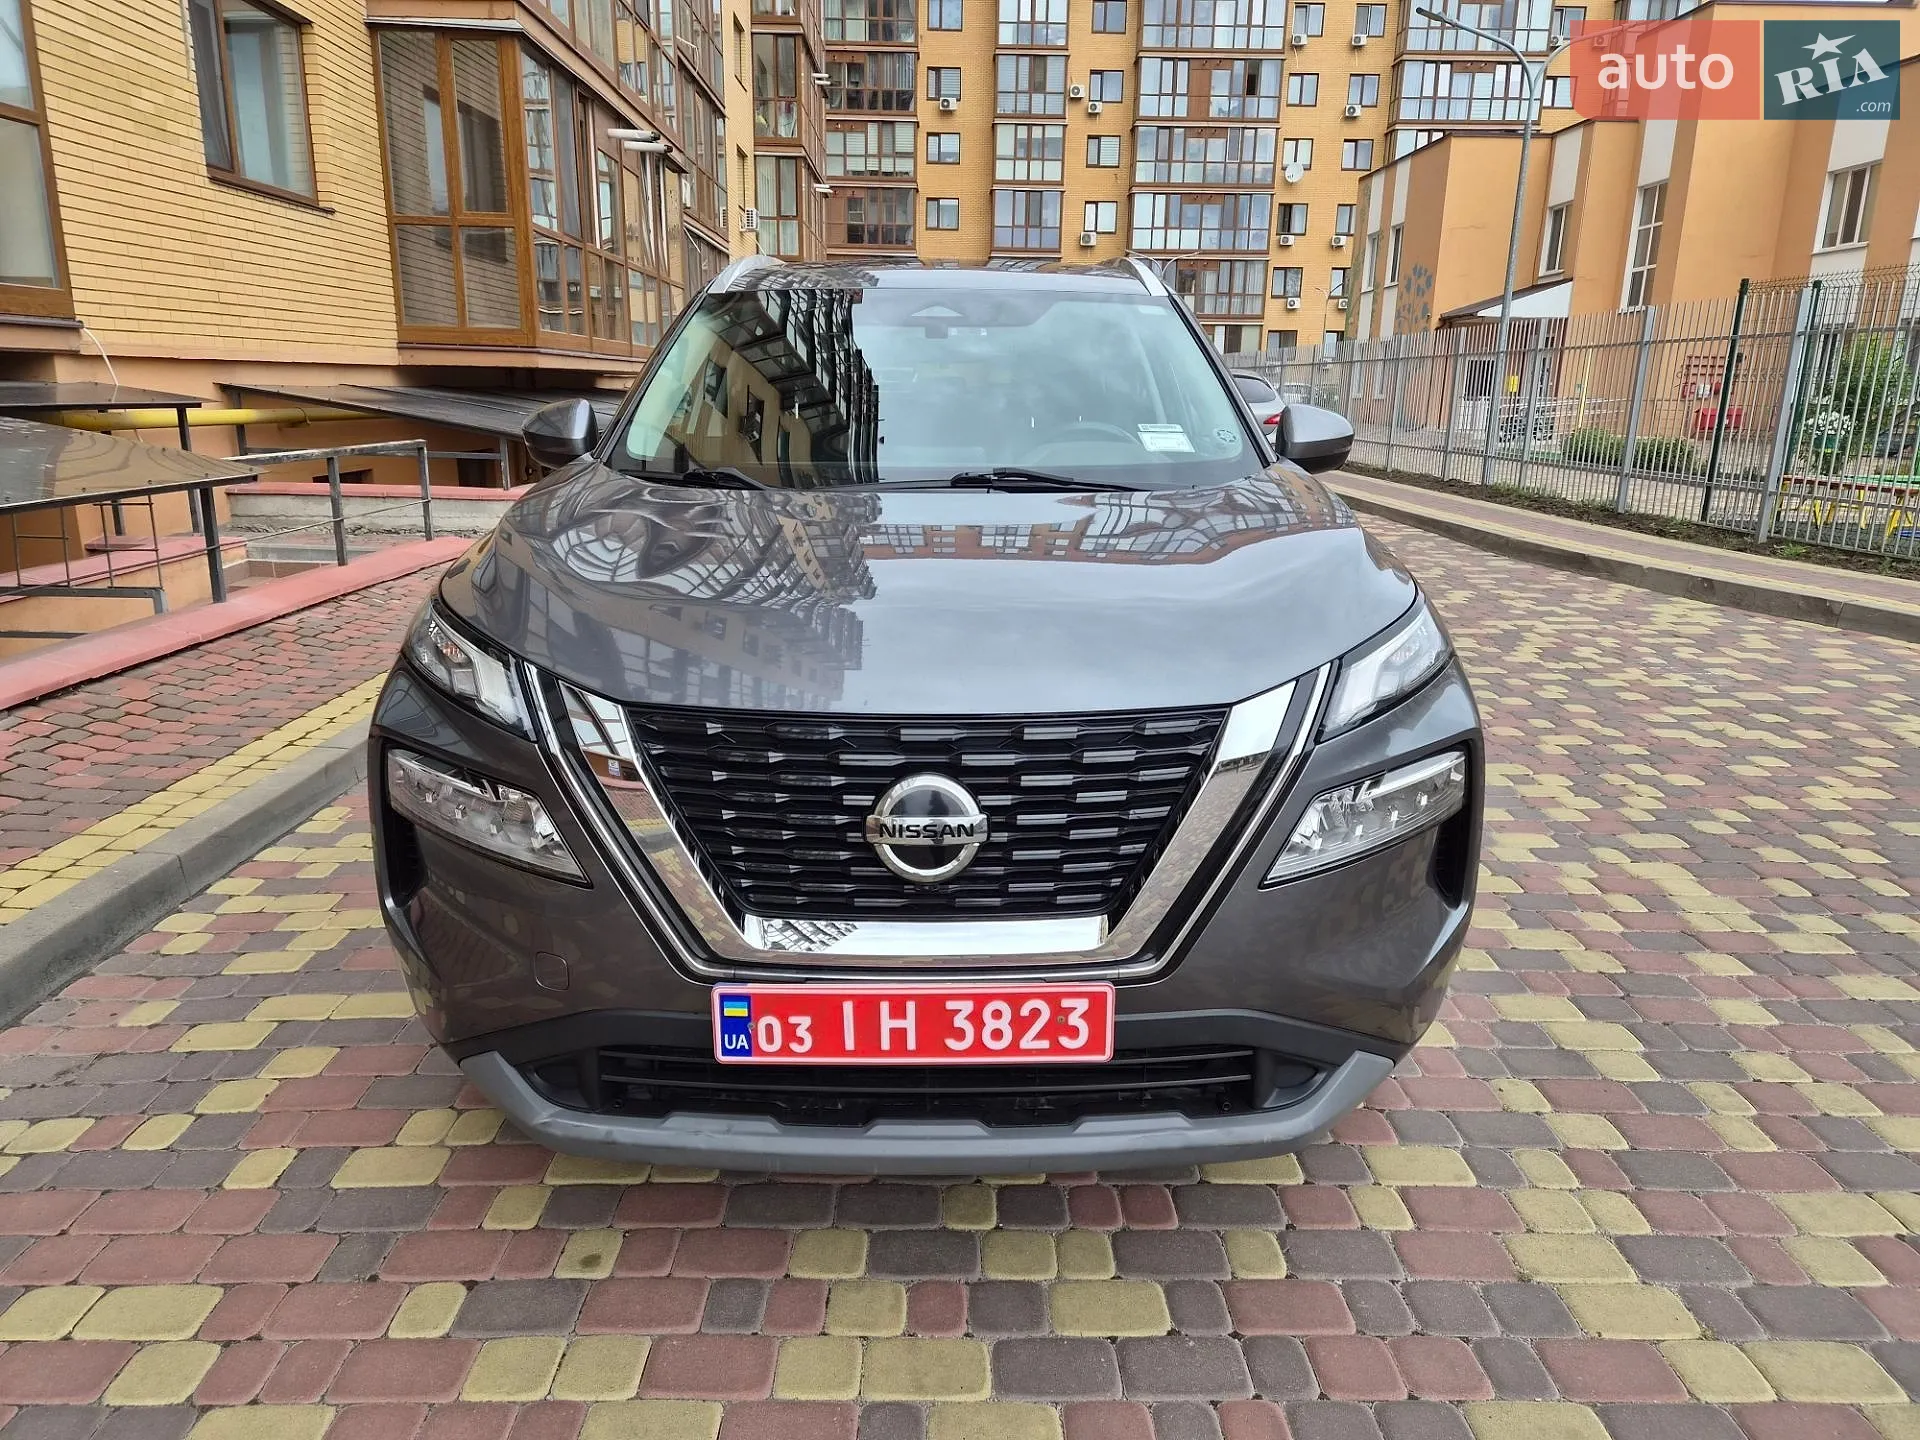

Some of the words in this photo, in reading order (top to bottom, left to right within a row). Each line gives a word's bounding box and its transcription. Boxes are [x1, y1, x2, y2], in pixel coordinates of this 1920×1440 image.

[879, 823, 975, 839] NISSAN
[757, 1015, 813, 1053] 03
[944, 998, 1090, 1051] 3823
[724, 1034, 749, 1050] UA
